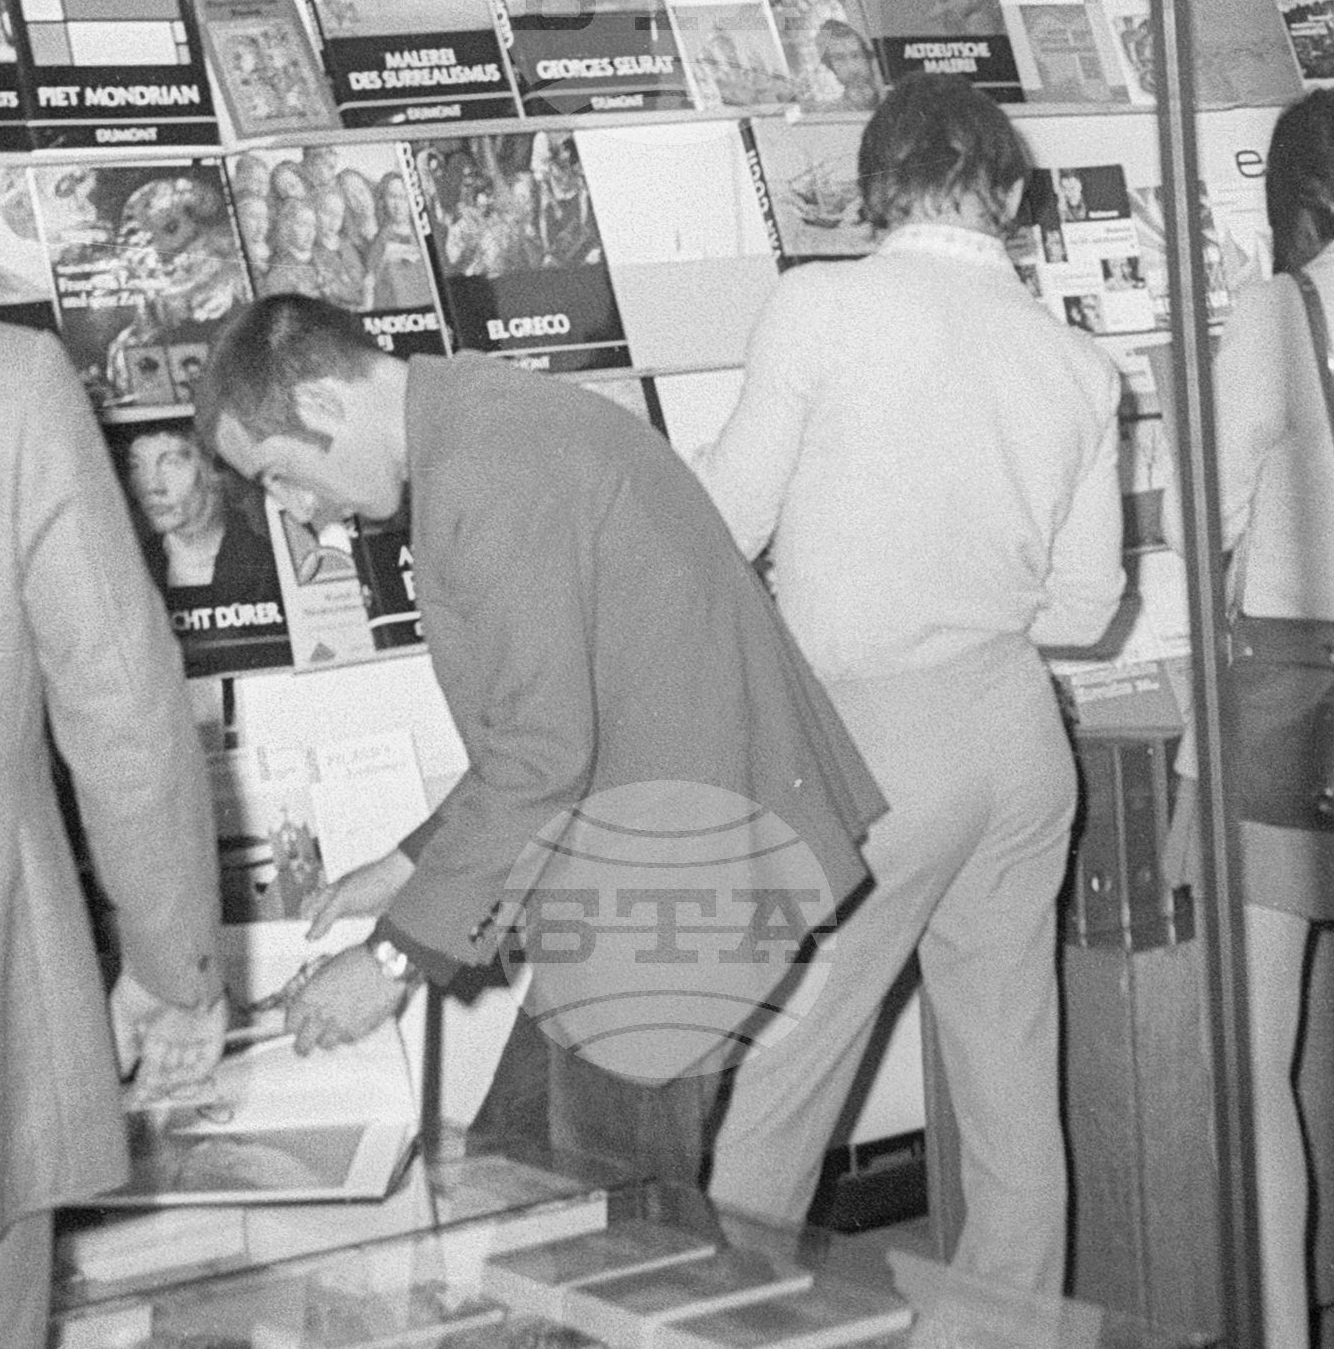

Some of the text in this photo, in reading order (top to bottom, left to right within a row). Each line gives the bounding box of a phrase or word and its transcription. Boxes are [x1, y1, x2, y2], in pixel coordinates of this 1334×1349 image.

[385, 48, 456, 69] MALEREI
[536, 58, 612, 80] GEORGES
[349, 63, 501, 90] DES SURREALISMUS
[37, 85, 200, 107] PIET MONDRIAN
[95, 128, 158, 144] DUMONT
[487, 313, 571, 341] EL GRECO
[172, 606, 213, 631] CHT
[215, 601, 284, 628] DÜRER
